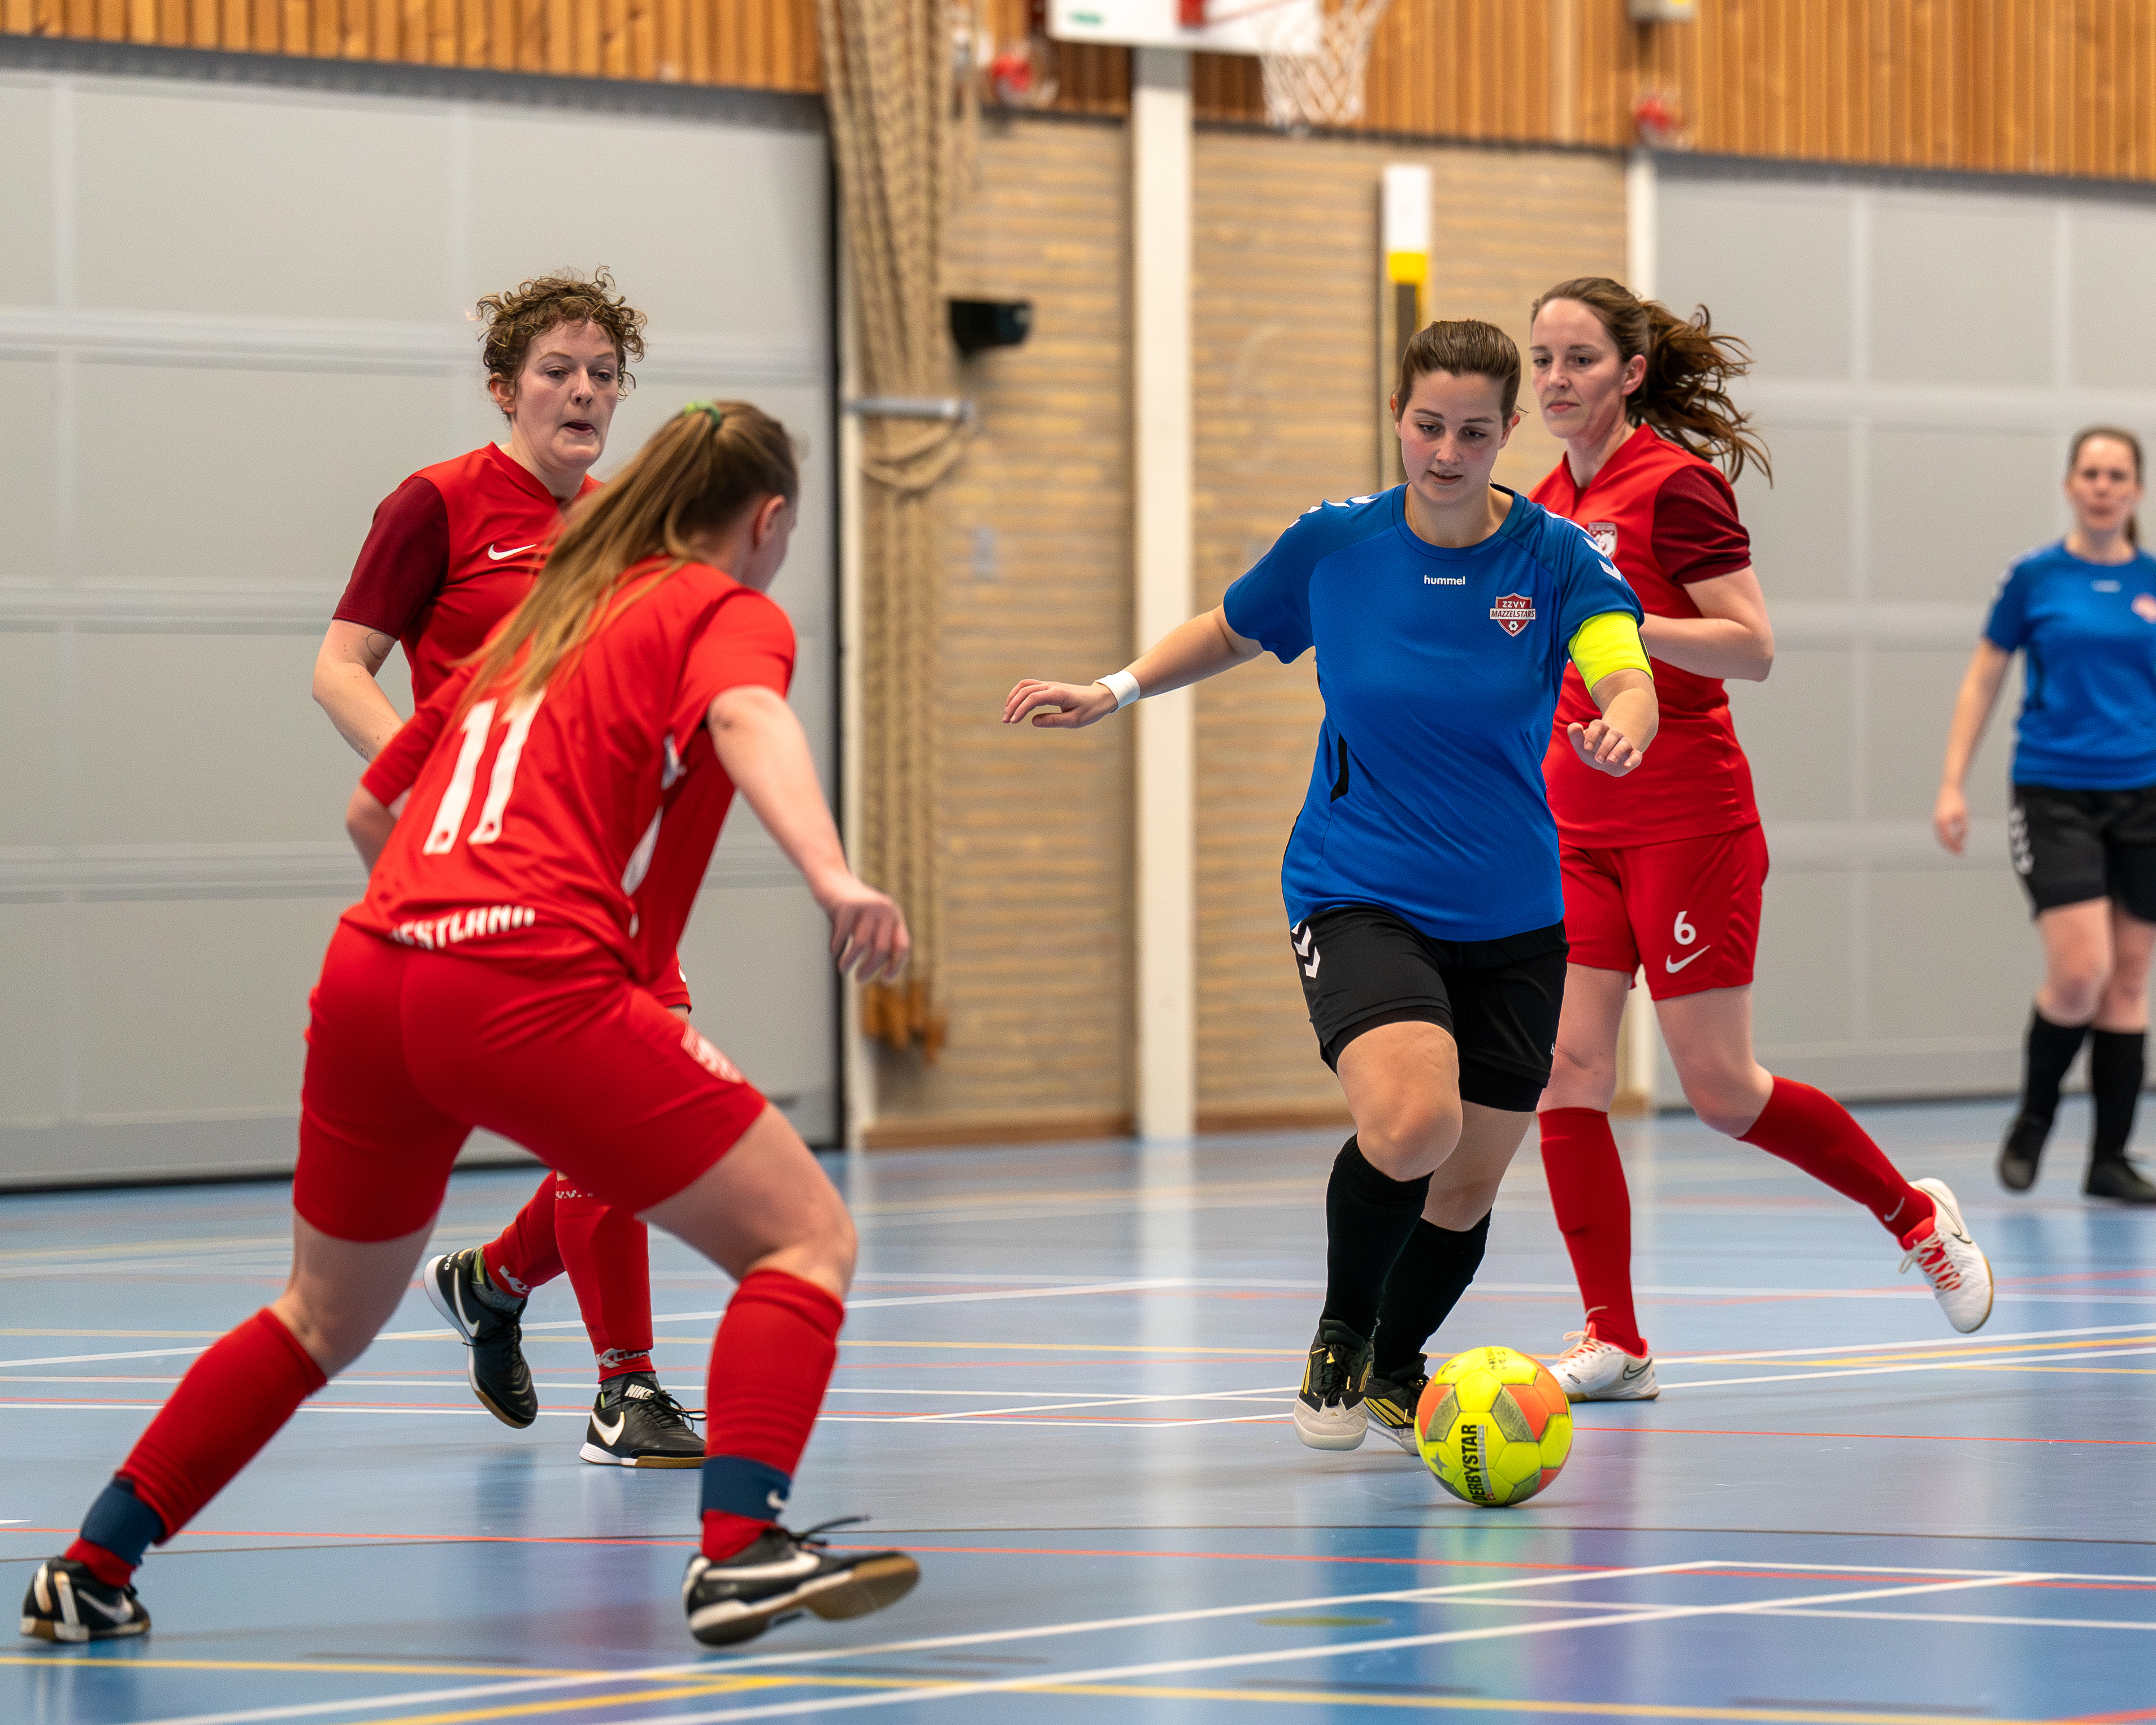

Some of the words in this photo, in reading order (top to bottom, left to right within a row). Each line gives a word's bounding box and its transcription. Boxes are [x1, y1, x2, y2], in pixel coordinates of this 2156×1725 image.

[1424, 574, 1466, 586] hummel
[423, 688, 546, 855] 11
[1673, 910, 1697, 946] 6
[1461, 1424, 1488, 1501] DERBYSTAR
